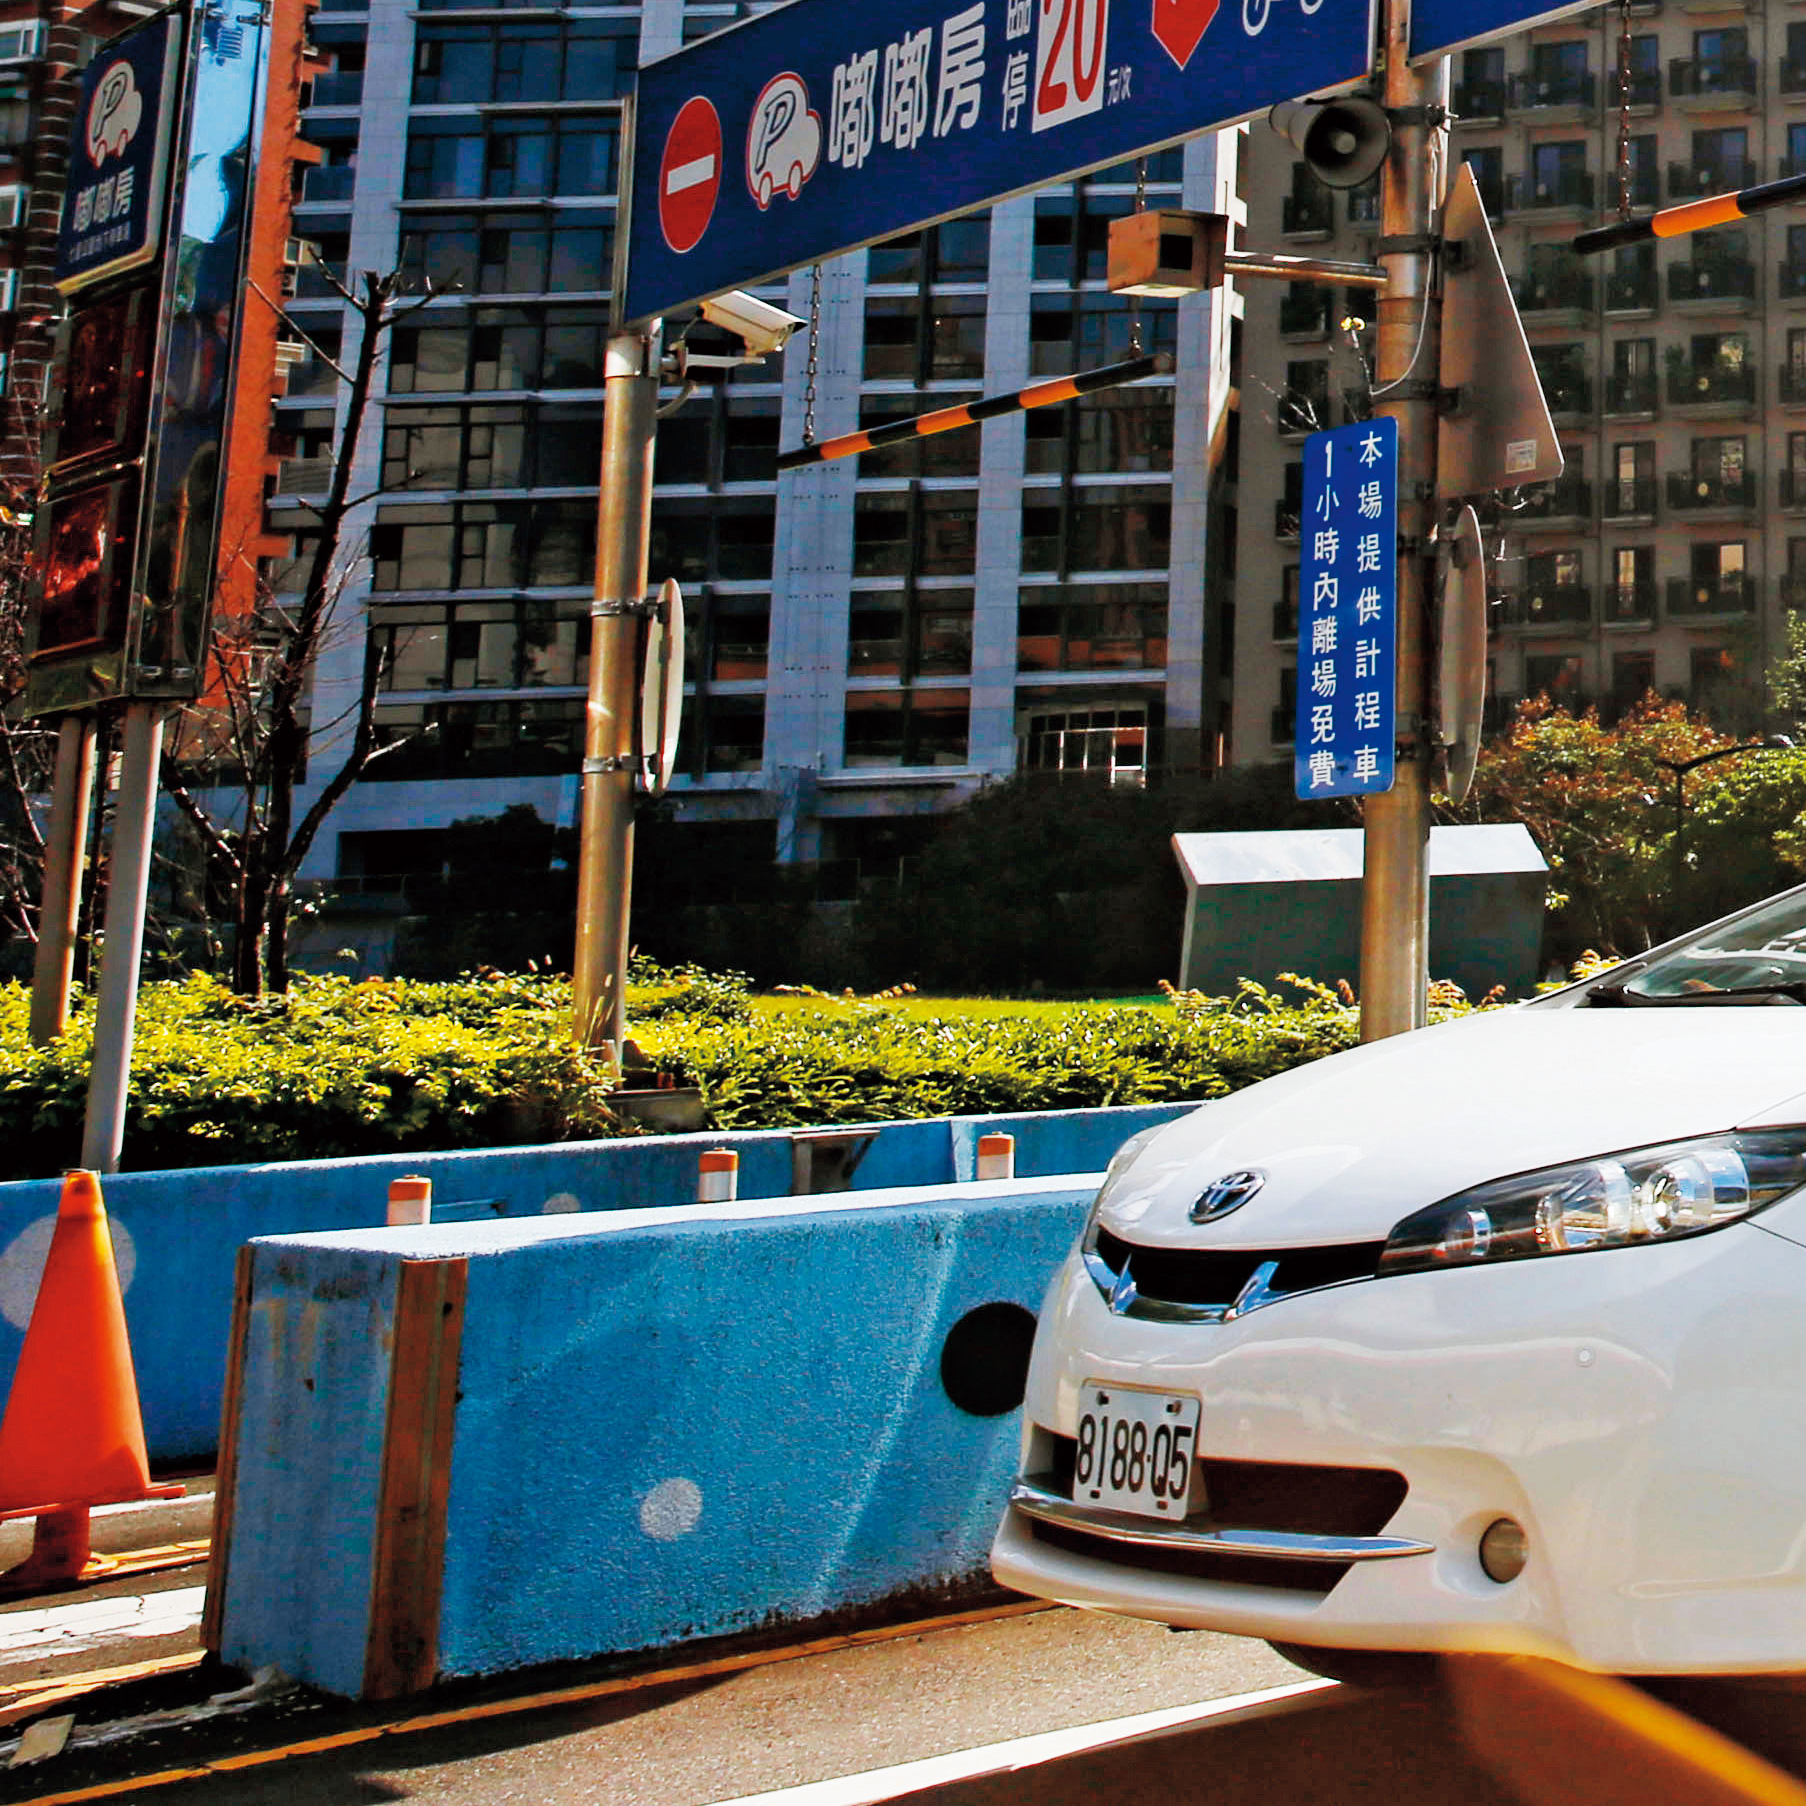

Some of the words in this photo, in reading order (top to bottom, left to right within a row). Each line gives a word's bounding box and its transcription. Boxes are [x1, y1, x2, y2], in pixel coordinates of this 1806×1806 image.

[756, 95, 796, 173] P
[828, 0, 986, 169] 嘟嘟房
[1308, 440, 1340, 789] 1小時內離場免費
[1352, 431, 1382, 784] 本場提供計程車
